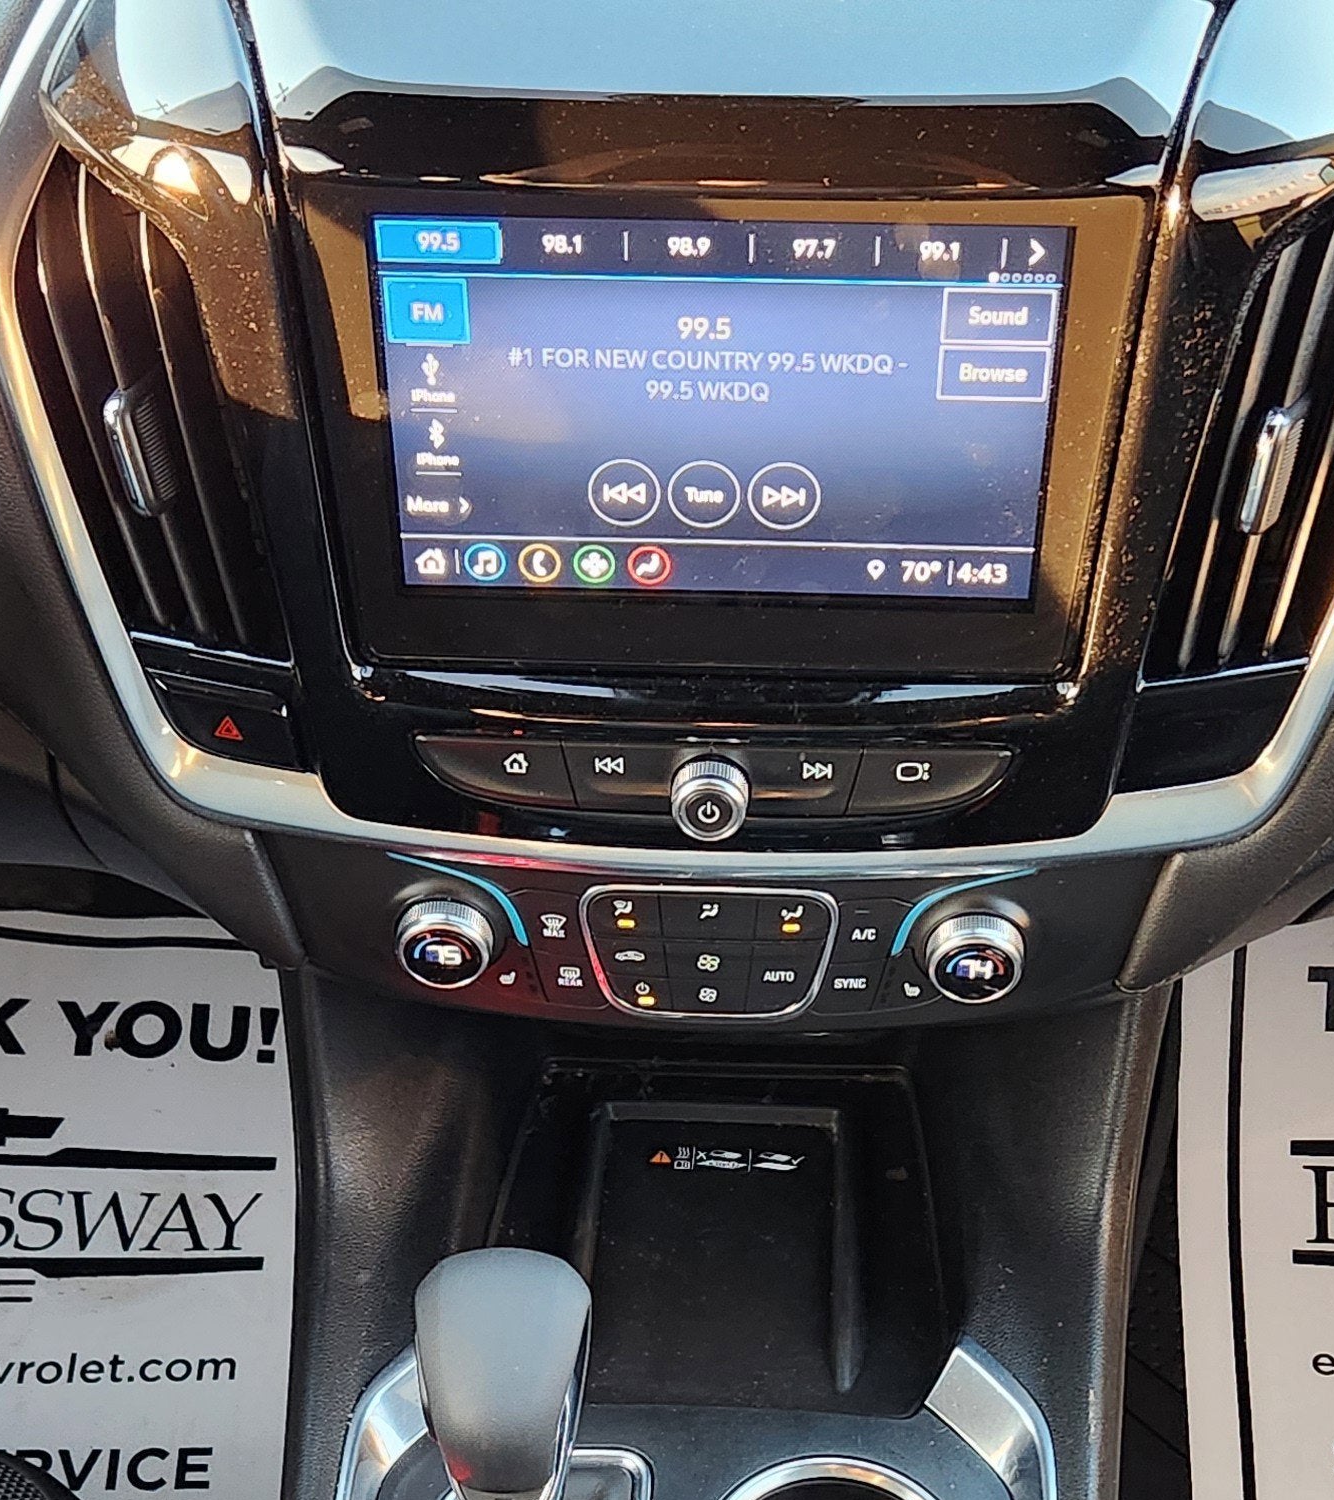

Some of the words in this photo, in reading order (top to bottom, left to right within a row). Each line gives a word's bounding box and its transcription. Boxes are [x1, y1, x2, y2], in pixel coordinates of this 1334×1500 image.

[417, 230, 460, 251] 99.5
[541, 233, 582, 255] 98.1
[667, 235, 712, 258] 98.9
[792, 238, 837, 260] 97.7
[919, 240, 961, 262] 99.1
[411, 303, 443, 322] FM
[968, 305, 1029, 327] Sound
[677, 317, 732, 340] 99.5
[508, 347, 534, 368] #1
[542, 348, 590, 369] FOR
[595, 349, 649, 370] NEW
[651, 350, 768, 372] COUNTRY
[768, 353, 816, 373] 99.5
[820, 353, 895, 375] WKDQ
[959, 363, 1028, 384] Browse
[645, 380, 694, 401] 99.5
[697, 381, 770, 403] WKDQ
[406, 495, 450, 513] More
[684, 486, 724, 503] Tune
[956, 562, 1008, 585] 4:43
[851, 928, 877, 941] A/C
[763, 970, 795, 983] AUTO
[833, 977, 867, 990] SYNC
[58, 1000, 280, 1064] YOU!
